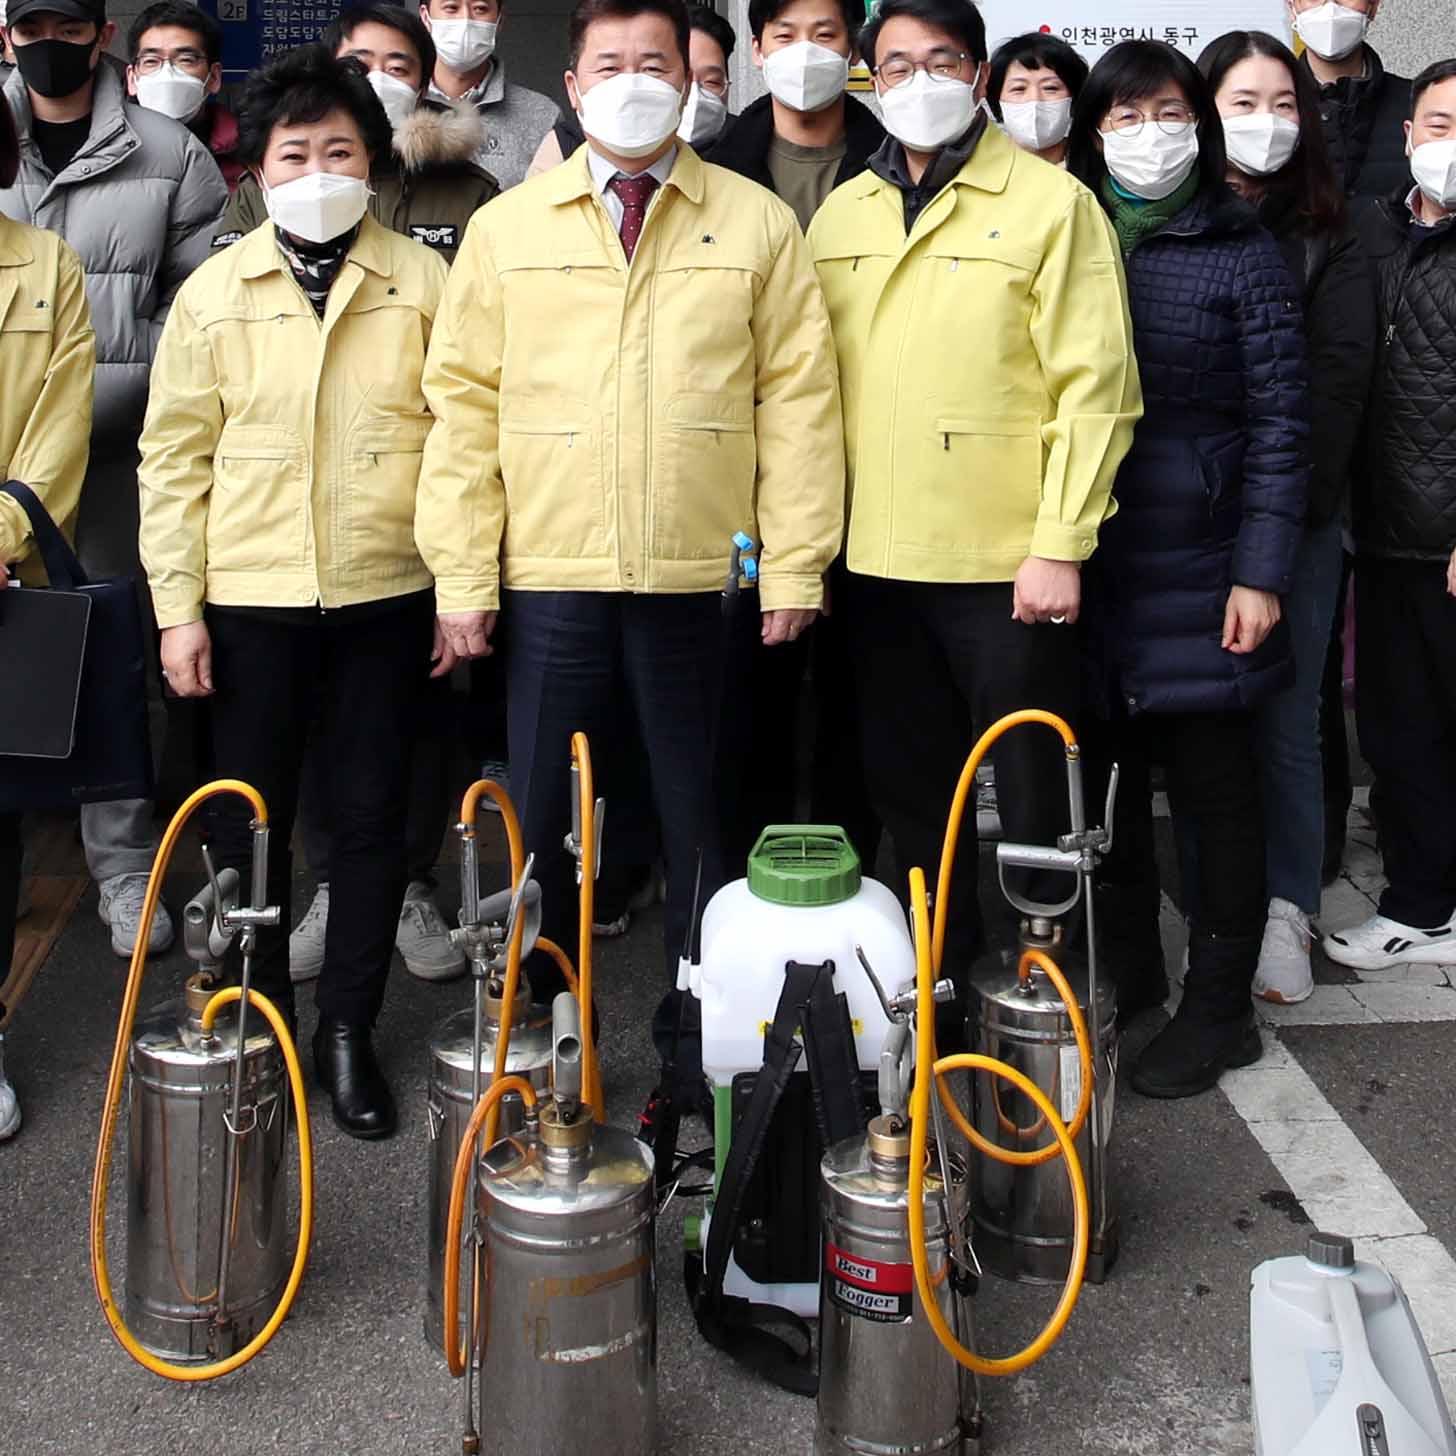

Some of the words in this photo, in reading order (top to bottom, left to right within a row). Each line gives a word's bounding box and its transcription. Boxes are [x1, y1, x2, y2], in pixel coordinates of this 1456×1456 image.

[224, 1, 245, 19] 2F
[1061, 26, 1154, 47] 인천광역시
[1163, 26, 1199, 47] 동구
[837, 1257, 873, 1280] Best
[838, 1281, 894, 1308] Fogger
